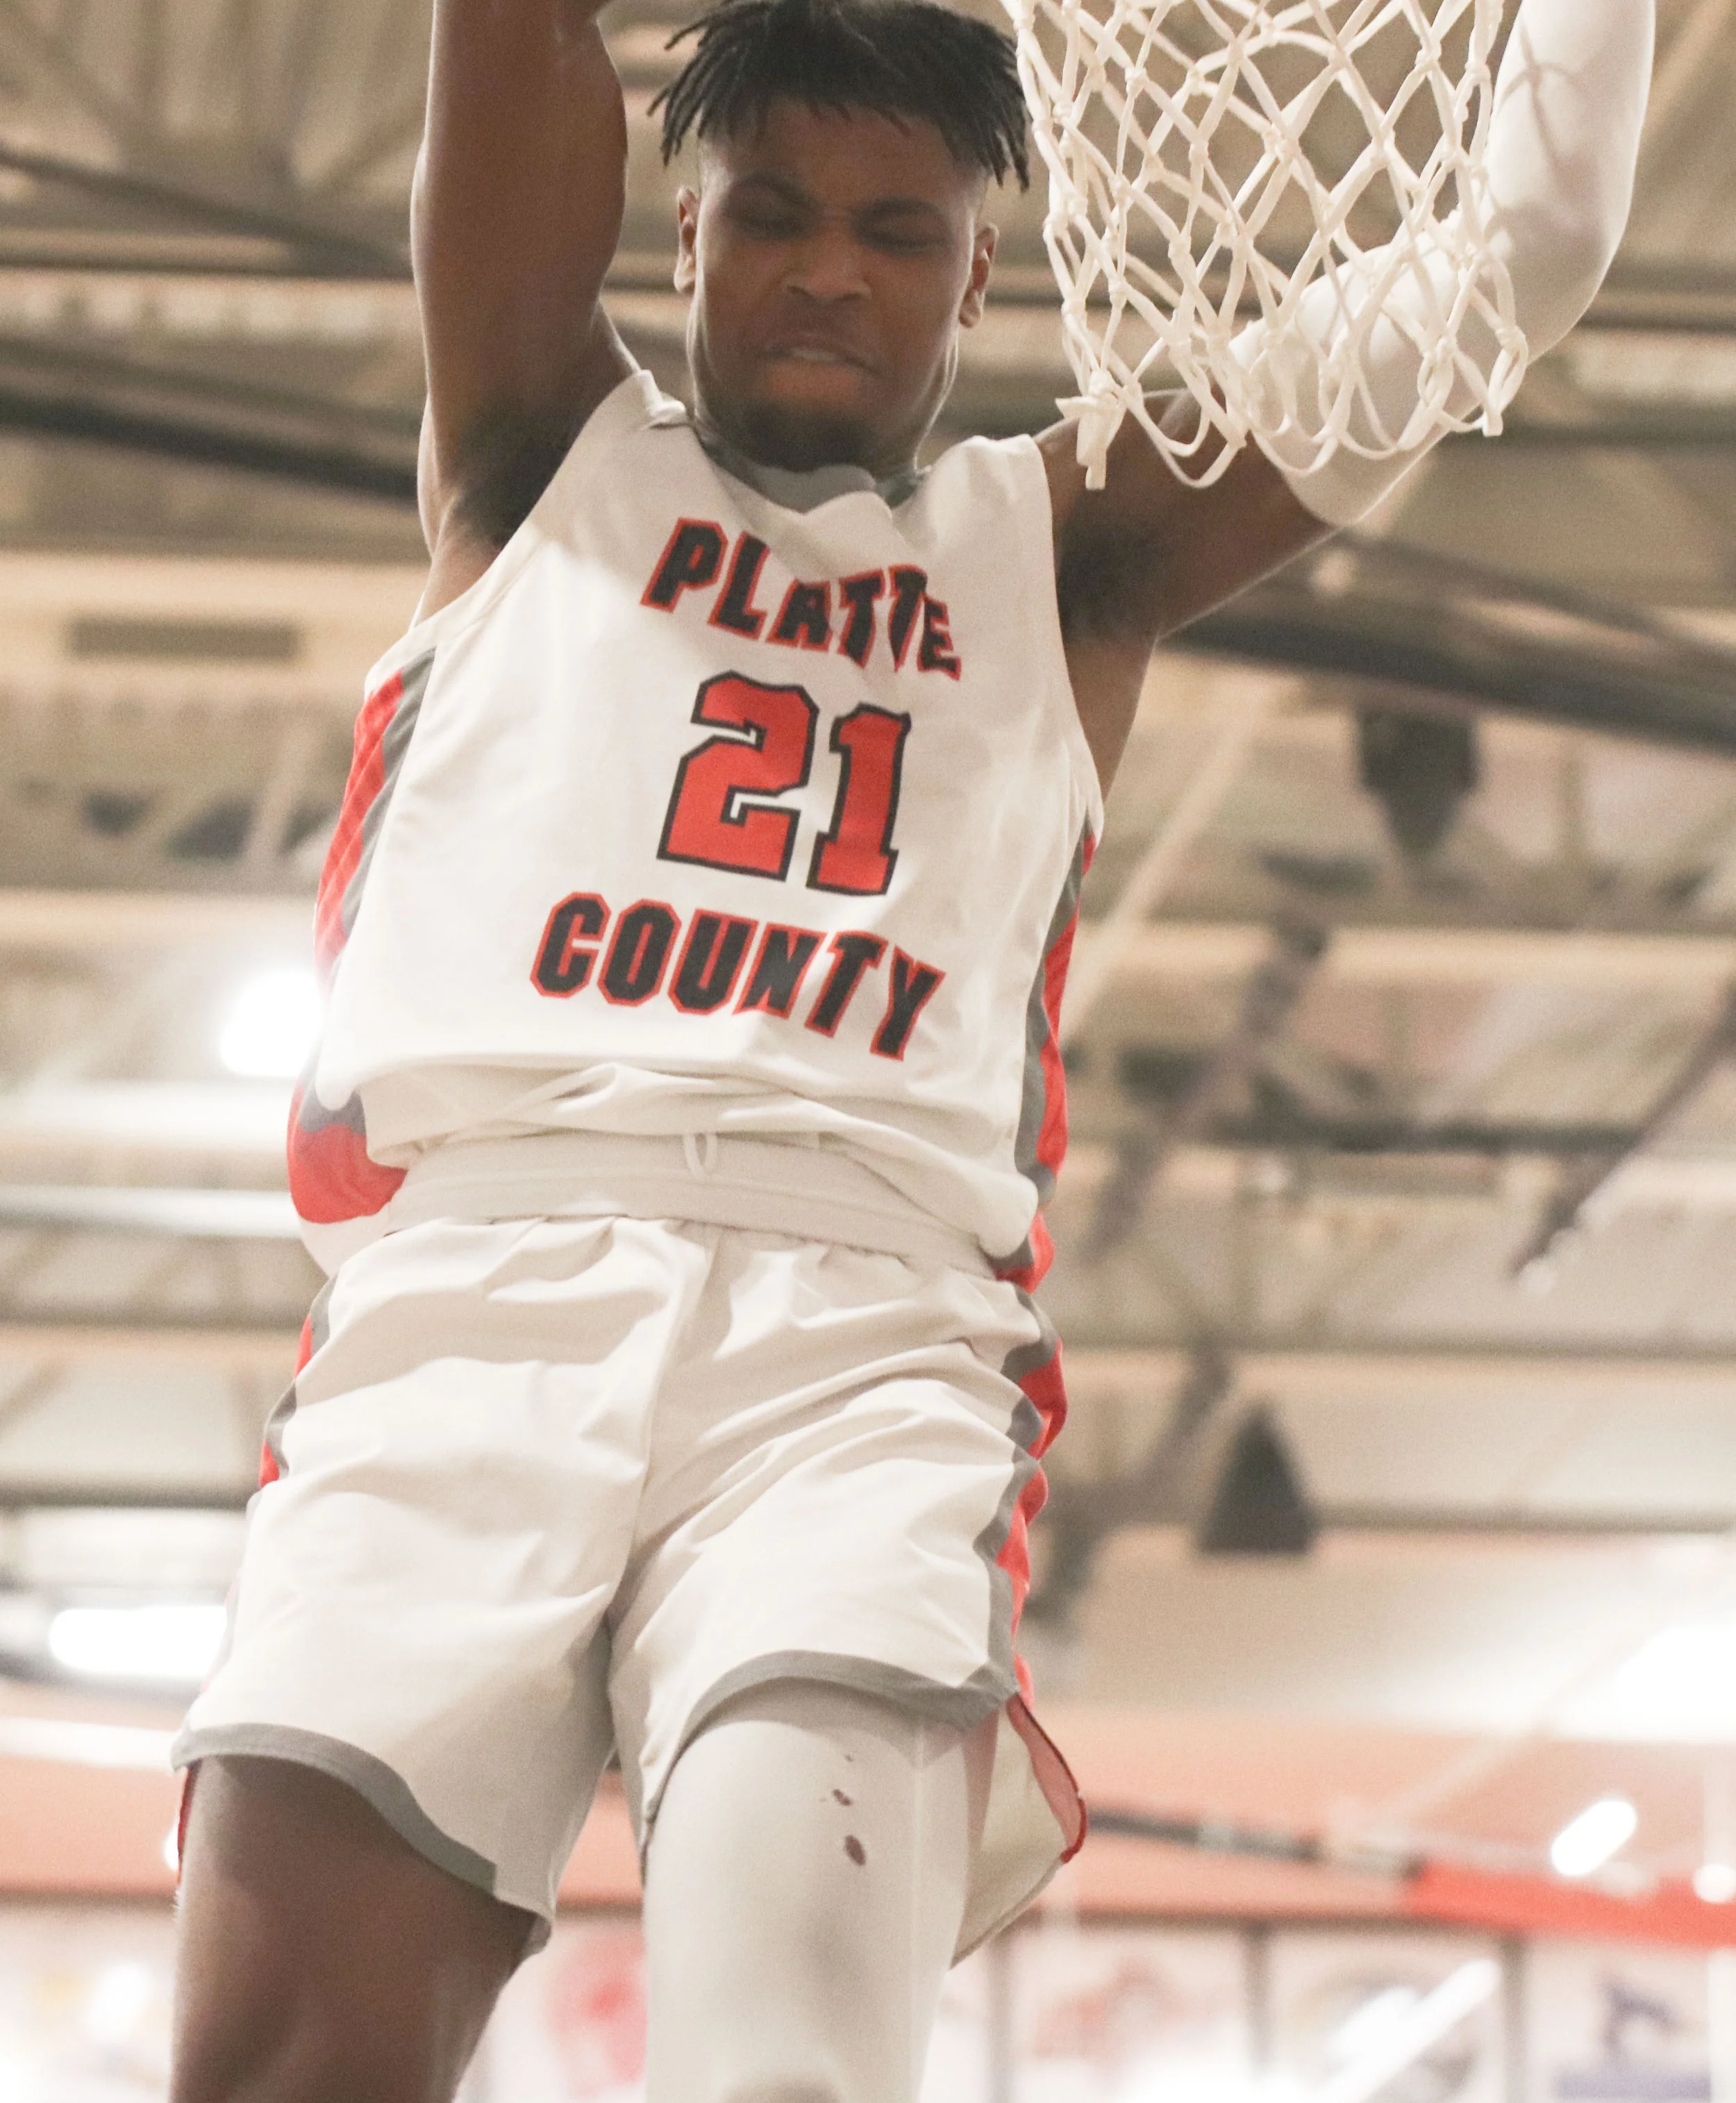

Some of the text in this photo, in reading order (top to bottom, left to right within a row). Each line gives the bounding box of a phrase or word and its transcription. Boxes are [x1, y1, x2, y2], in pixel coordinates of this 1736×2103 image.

[640, 517, 962, 681] PLATTE
[656, 670, 912, 896] 21
[530, 891, 946, 1061] COUNTY
